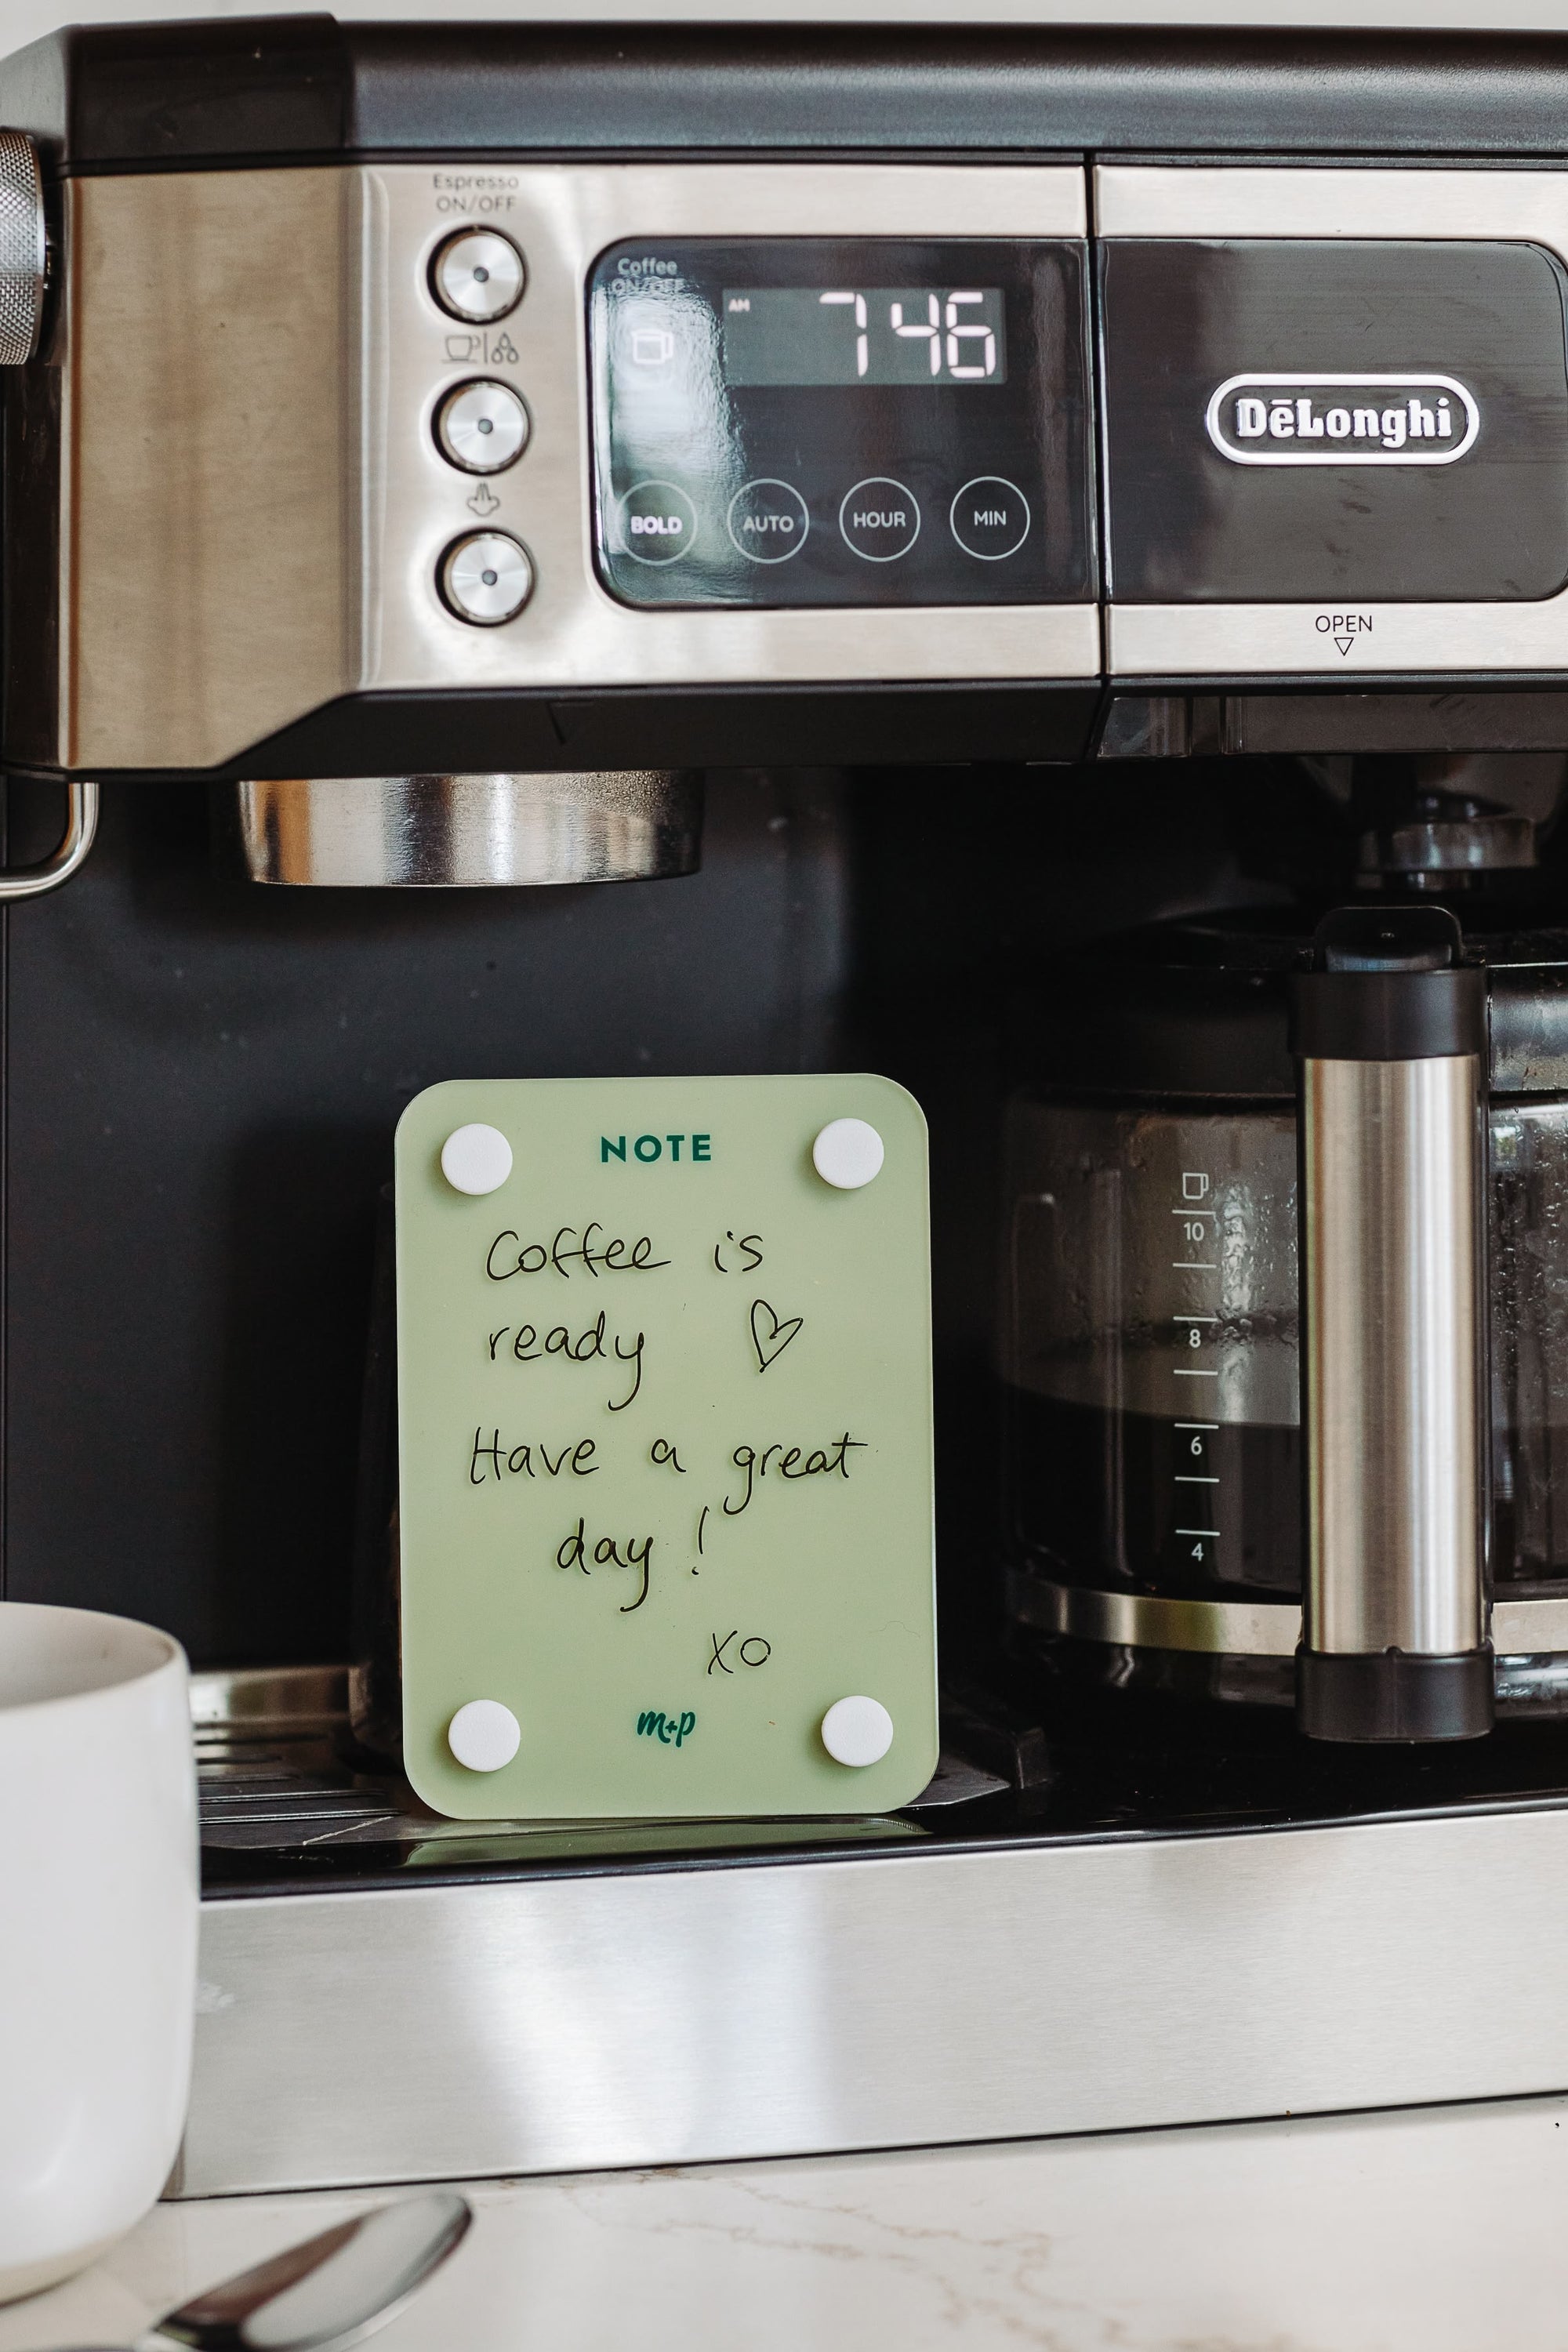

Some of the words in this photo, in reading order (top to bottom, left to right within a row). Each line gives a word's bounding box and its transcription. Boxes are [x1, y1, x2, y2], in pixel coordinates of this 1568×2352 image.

[433, 173, 519, 191] Espresso
[436, 195, 517, 212] ON/OFF
[617, 256, 678, 275] Coffee
[728, 298, 750, 312] AM
[630, 515, 684, 535] BOLD
[742, 515, 794, 534] AUTO
[853, 510, 906, 528] HOUR
[974, 510, 1007, 527] MIN
[1315, 615, 1373, 633] OPEN
[601, 1134, 713, 1163] NOTE
[1183, 1221, 1205, 1242] 10
[486, 1221, 672, 1282] Coffee
[713, 1230, 764, 1273] is
[1189, 1328, 1202, 1348] 8
[488, 1309, 645, 1412] ready
[1190, 1436, 1203, 1456] 6
[470, 1426, 600, 1485] Have
[651, 1438, 687, 1473] a
[723, 1431, 869, 1516] great
[1191, 1542, 1204, 1562] 4
[556, 1516, 654, 1613] day
